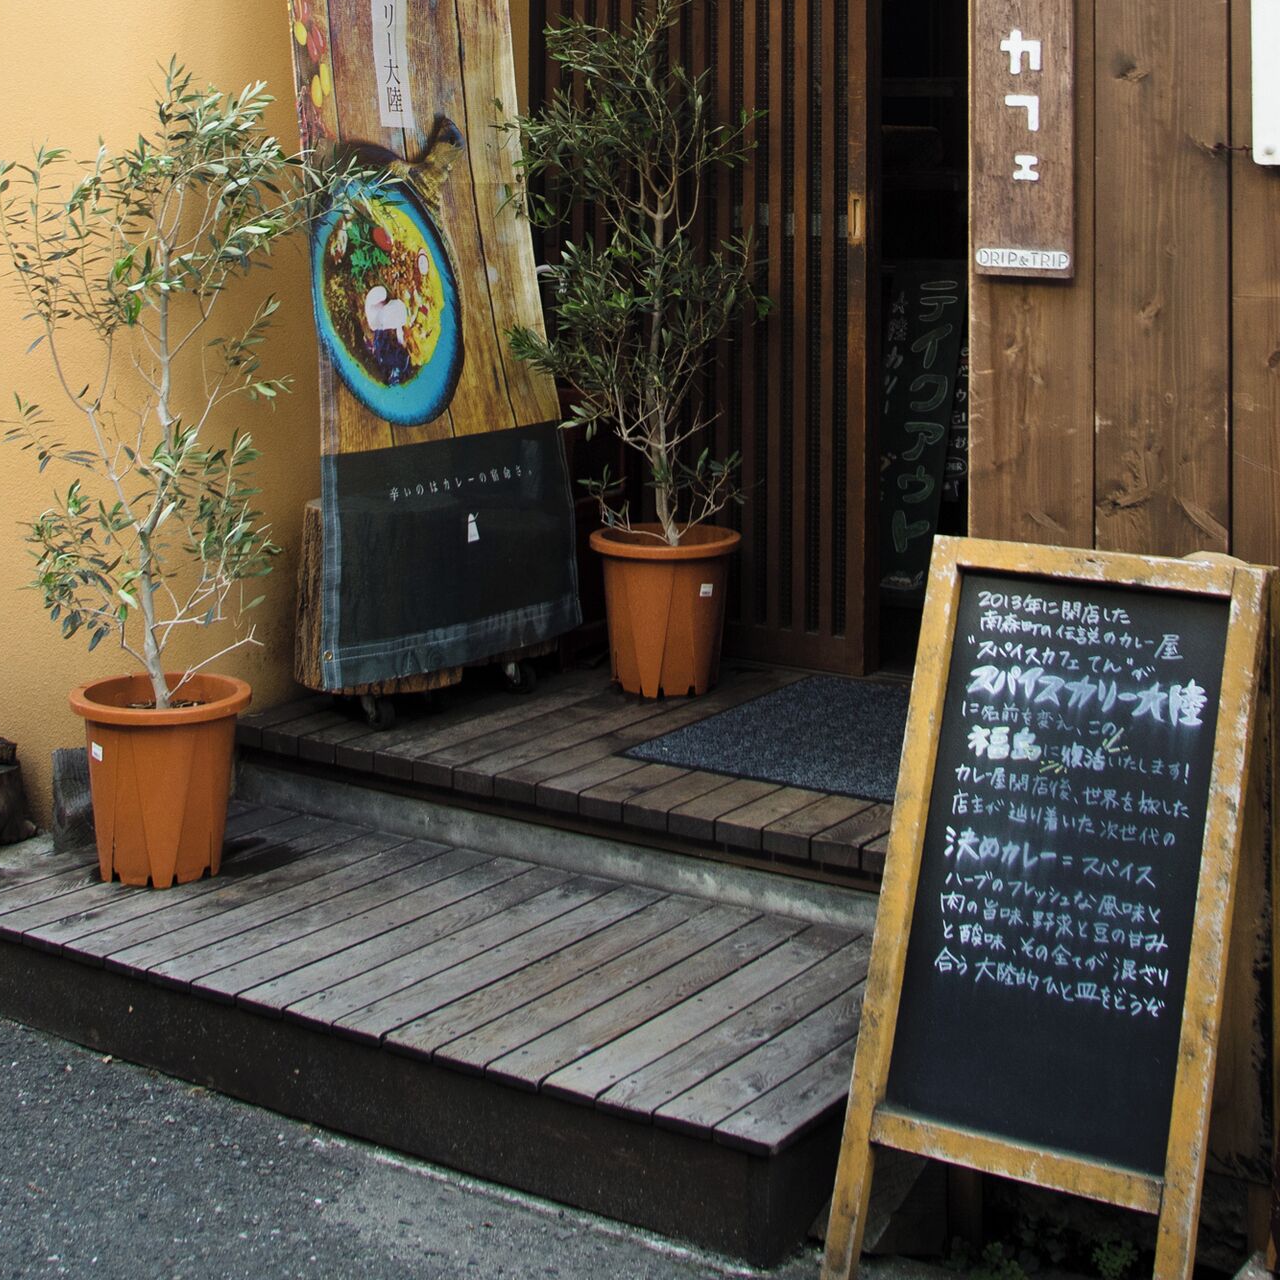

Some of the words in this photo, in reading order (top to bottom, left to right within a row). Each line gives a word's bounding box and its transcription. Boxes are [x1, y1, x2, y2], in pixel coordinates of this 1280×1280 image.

[966, 664, 1208, 727] スパイスカリー大陸
